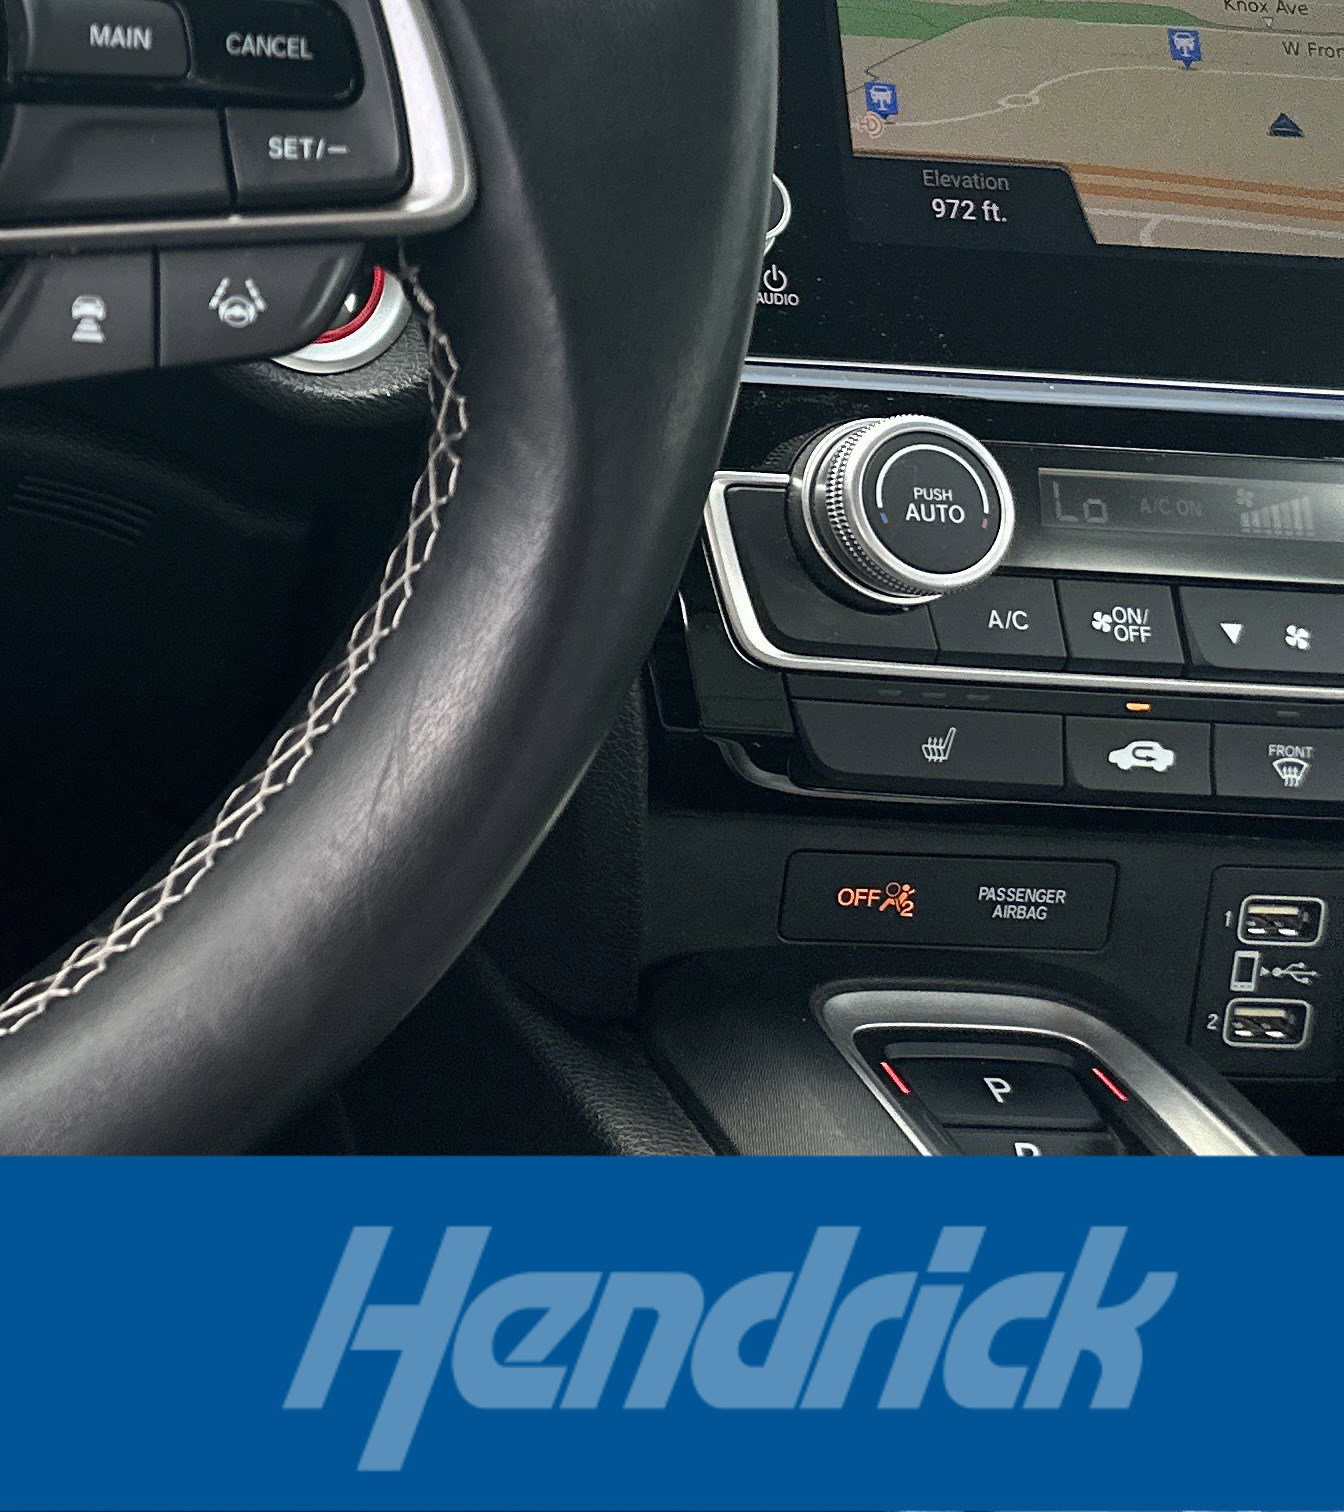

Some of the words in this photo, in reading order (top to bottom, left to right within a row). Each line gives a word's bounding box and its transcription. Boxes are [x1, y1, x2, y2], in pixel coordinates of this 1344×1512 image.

[1276, 0, 1309, 16] Ave
[89, 23, 152, 50] MAIN
[226, 33, 312, 59] CANCEL
[1282, 41, 1299, 56] W
[923, 169, 1010, 191] Elevation
[931, 198, 976, 220] 972
[982, 200, 1007, 222] ft.
[756, 292, 799, 306] AUDIO
[913, 487, 953, 502] PUSH
[905, 503, 965, 524] AUTO
[988, 610, 1029, 630] A/C
[1112, 606, 1149, 624] ON/
[1113, 624, 1152, 643] OFF
[1268, 744, 1313, 759] FRONT
[837, 888, 882, 907] OFF
[978, 886, 1066, 904] PASSENGER
[992, 905, 1048, 921] AIRBAG
[1224, 910, 1232, 927] 1
[1206, 1014, 1219, 1031] 2
[983, 1077, 1011, 1103] P
